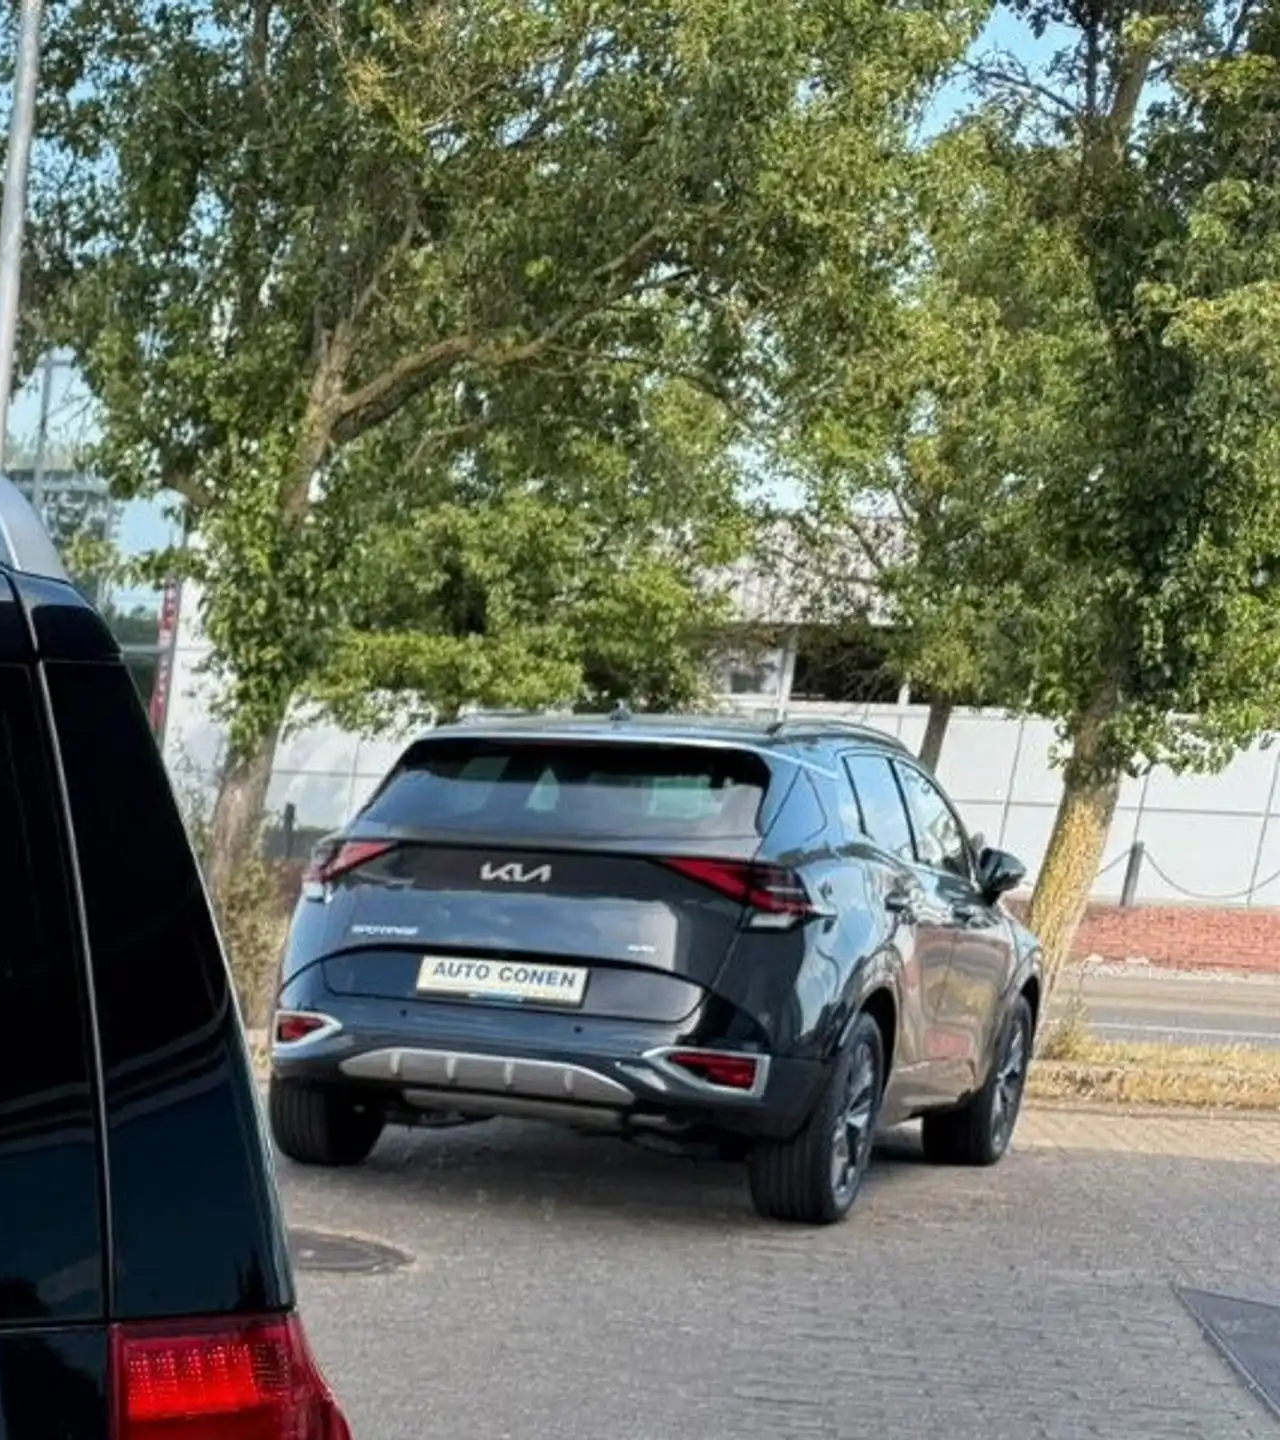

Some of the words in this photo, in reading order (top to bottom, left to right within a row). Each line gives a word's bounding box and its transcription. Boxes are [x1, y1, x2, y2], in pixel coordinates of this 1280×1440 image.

[480, 860, 553, 883] KIA
[432, 960, 490, 981] AUTO
[498, 966, 577, 989] CONEN
